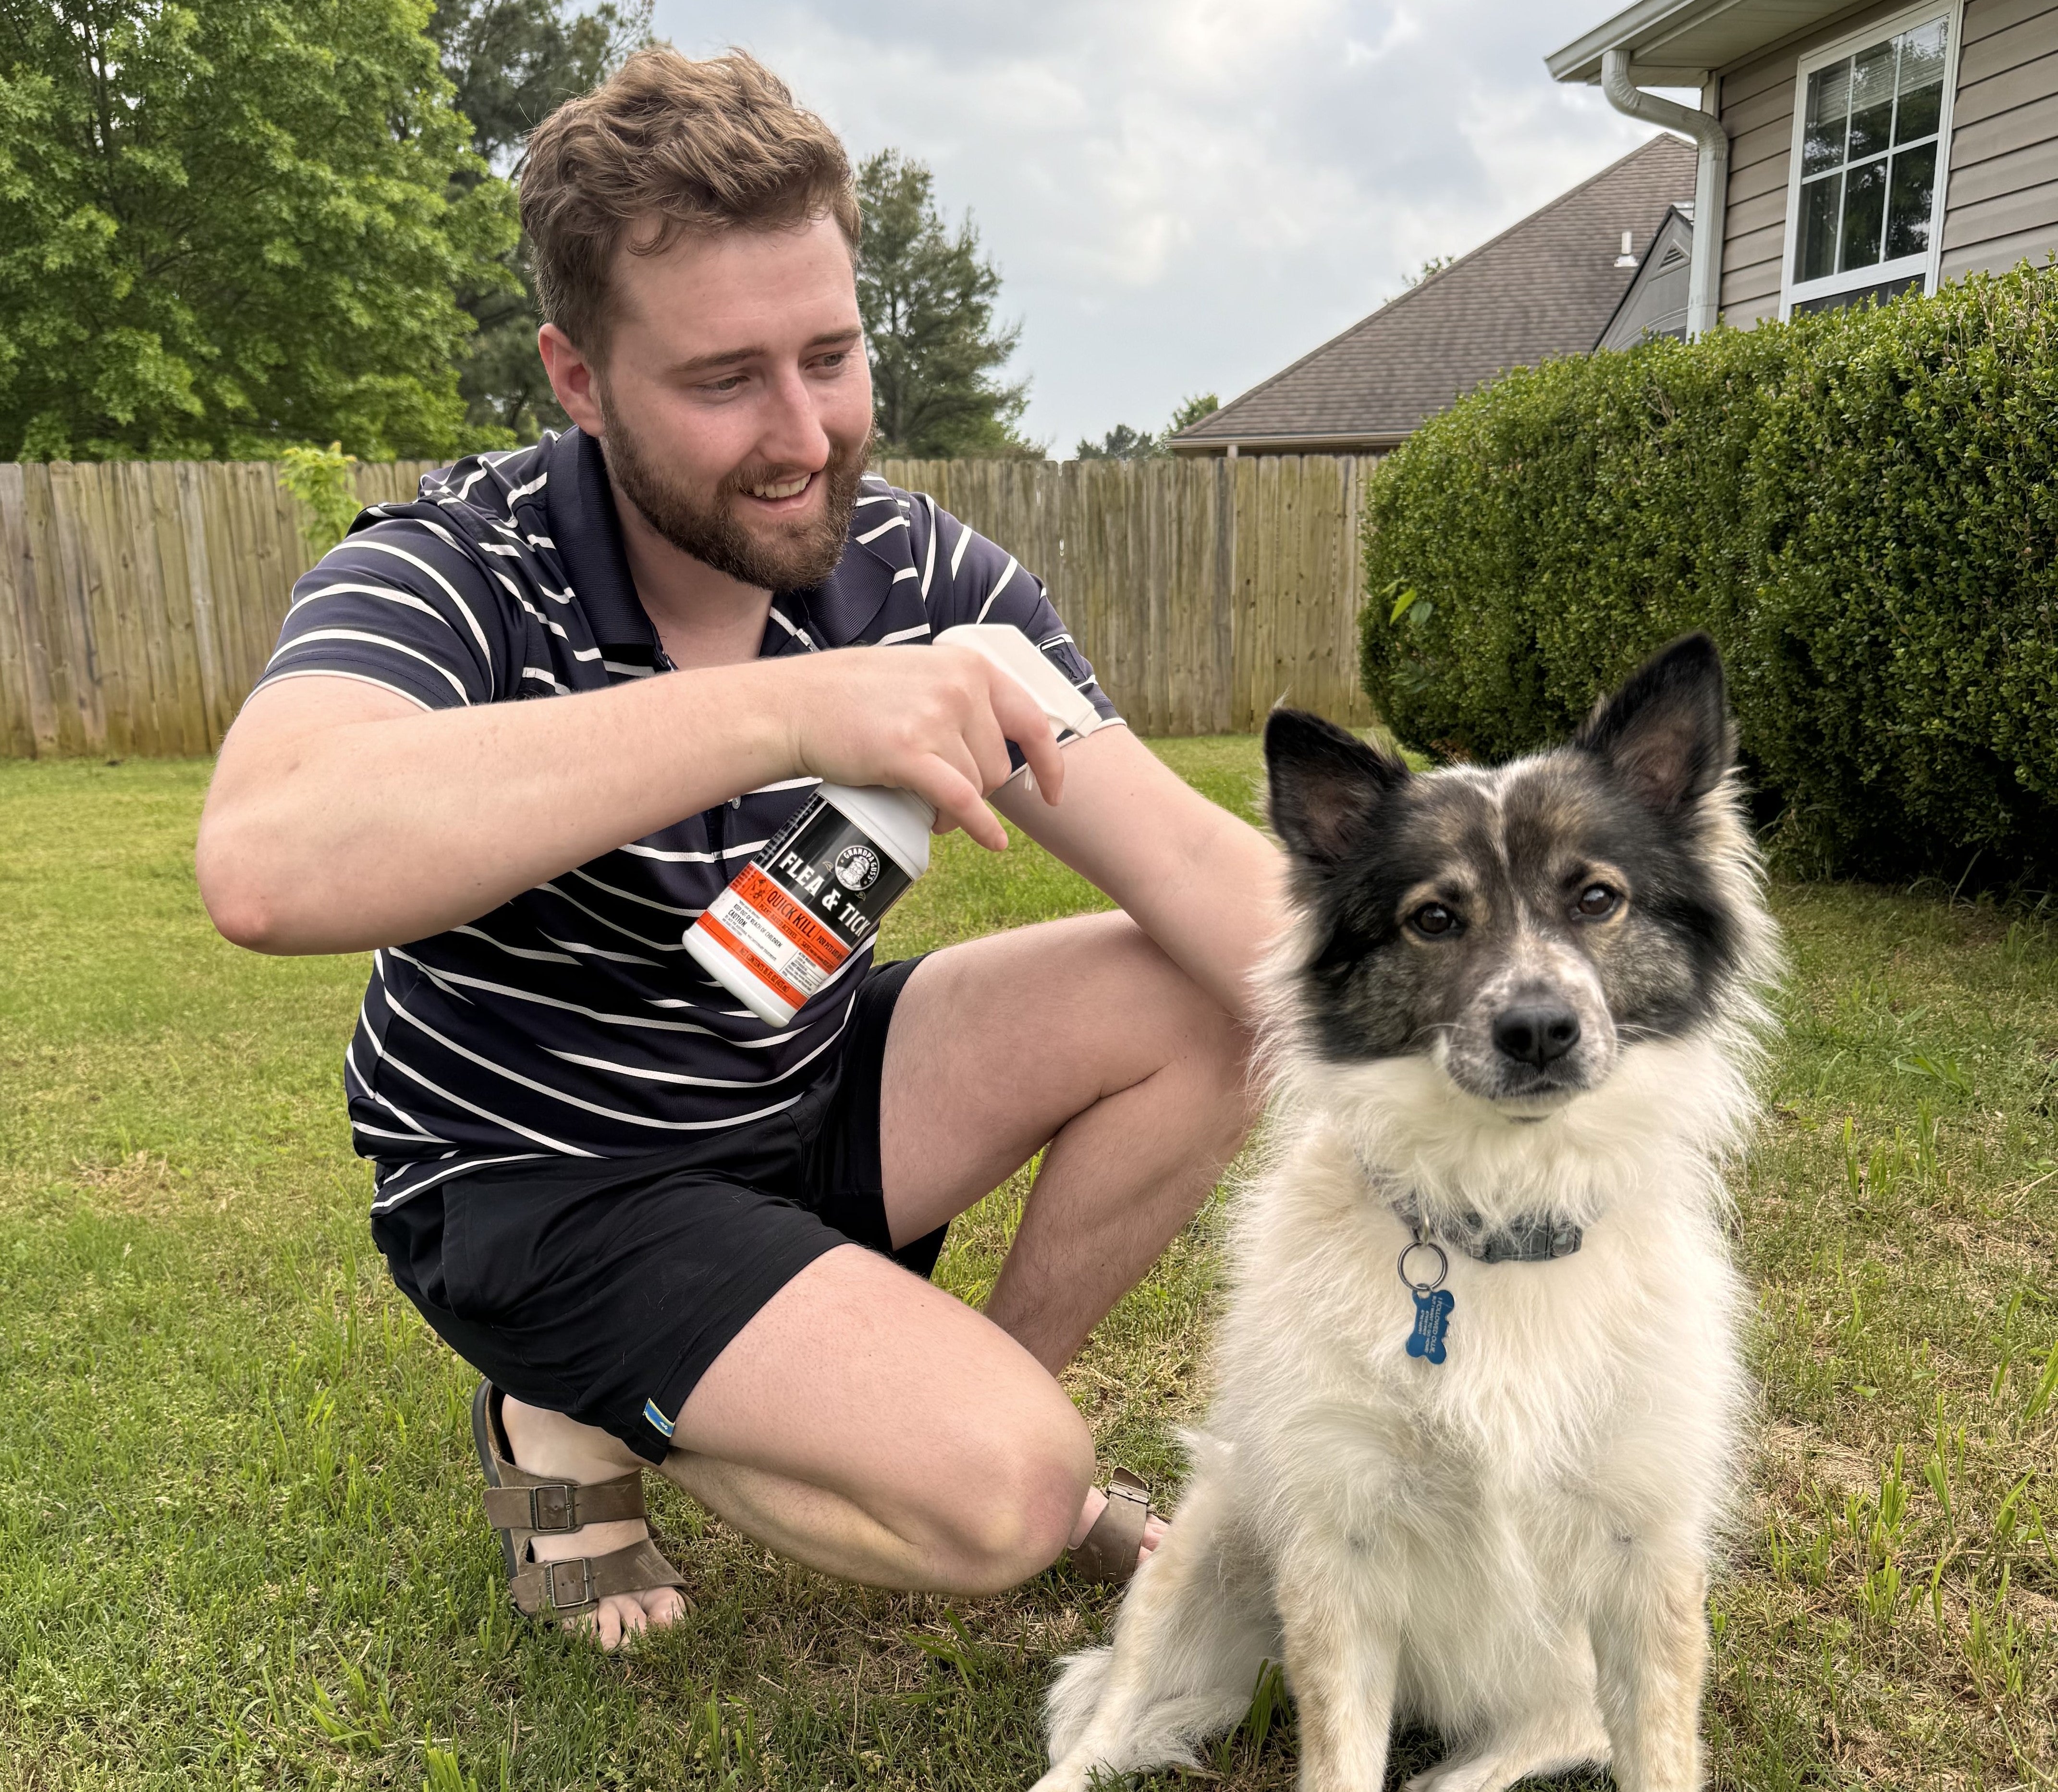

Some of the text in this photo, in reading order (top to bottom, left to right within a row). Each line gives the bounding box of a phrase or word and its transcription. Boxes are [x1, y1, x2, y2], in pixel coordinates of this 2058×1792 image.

[844, 848, 875, 862] GRANDPA
[778, 851, 824, 896] FLEA
[821, 888, 841, 911] &
[838, 903, 870, 936] TICK
[728, 909, 747, 927] CAUTION
[767, 891, 797, 920] QUICK
[793, 913, 816, 938] KILL
[750, 919, 762, 931] REACH
[765, 932, 783, 948] CHILDREN
[782, 924, 797, 939] ACTIVES
[817, 935, 825, 946] FOR
[747, 954, 764, 970] CONTENTS
[1433, 1300, 1442, 1335] FOLLOWED
